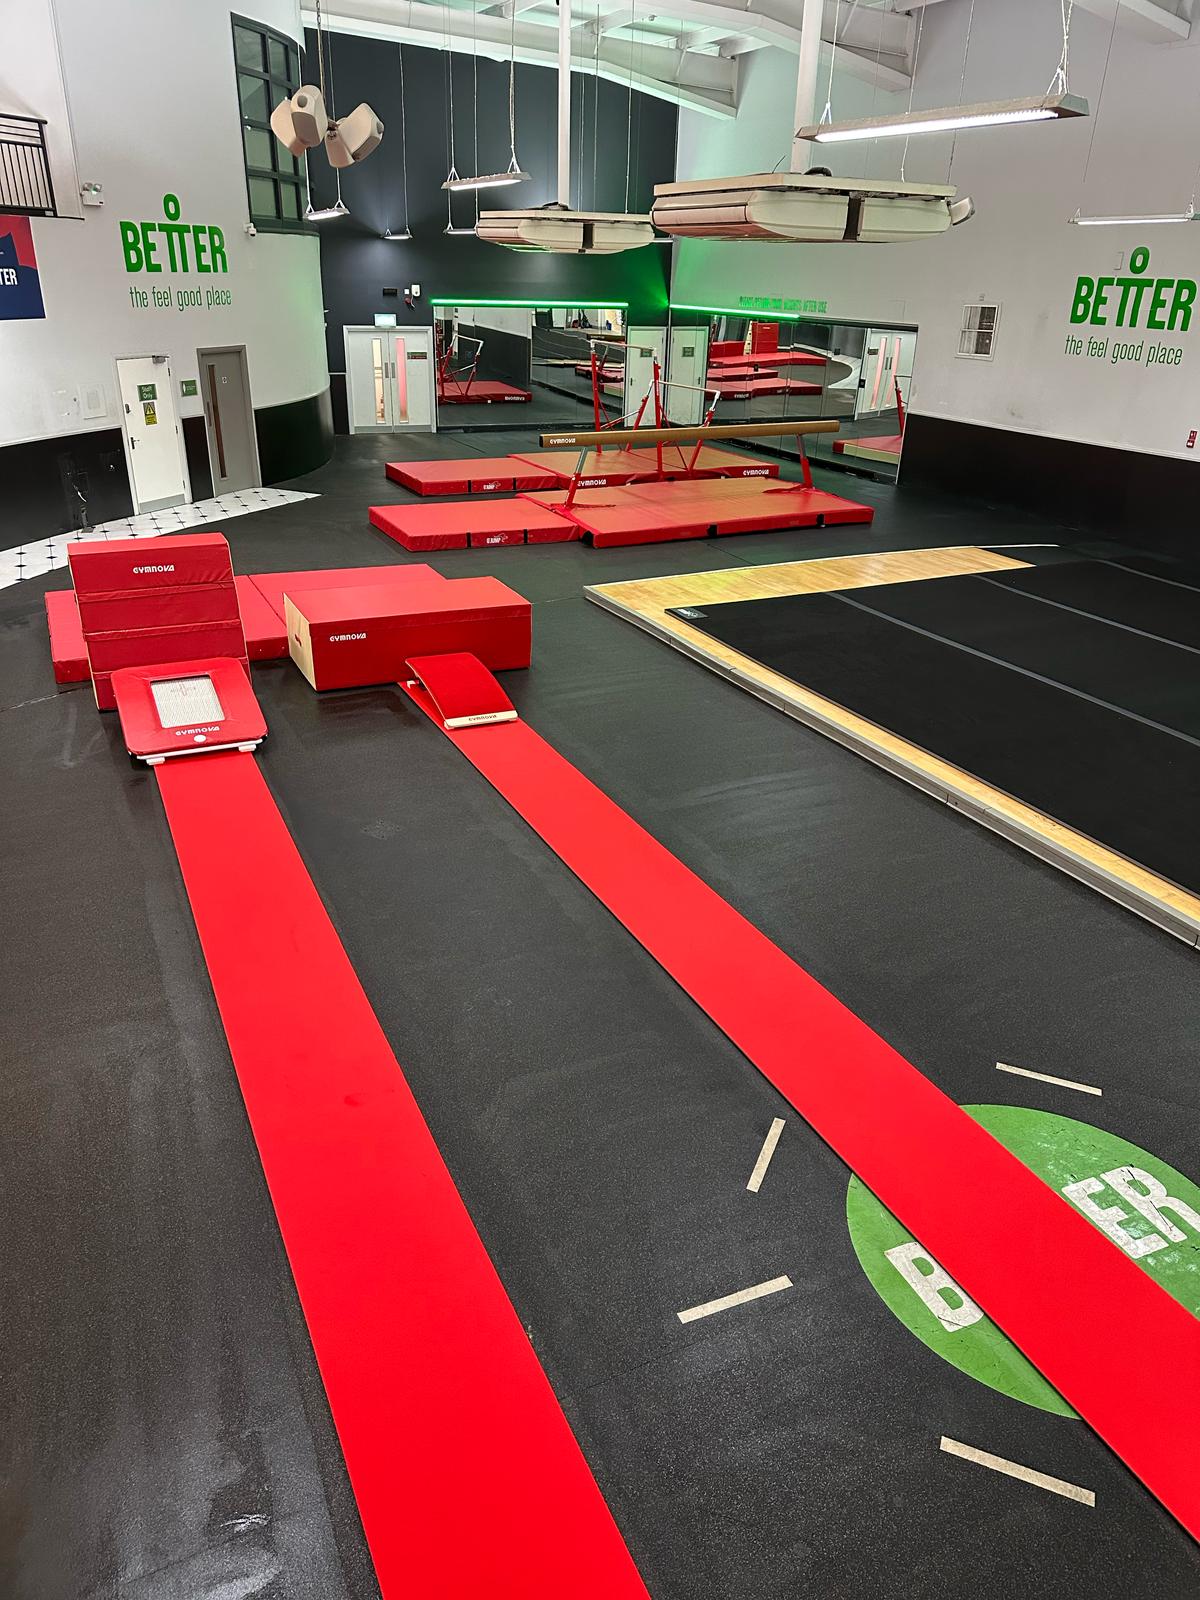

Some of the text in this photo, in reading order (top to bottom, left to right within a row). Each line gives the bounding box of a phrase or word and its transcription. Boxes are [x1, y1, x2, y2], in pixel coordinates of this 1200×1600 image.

[119, 221, 228, 273] BETTER
[129, 285, 232, 312] the feel good place
[1069, 276, 1198, 332] BETTER
[1065, 335, 1183, 367] the feel good place
[742, 468, 769, 476] GYMNOVA
[132, 564, 175, 574] GYMNOVA
[329, 632, 367, 642] GYMNOVA
[468, 714, 497, 722] GYMNOVA
[175, 726, 220, 736] GYMNOVA
